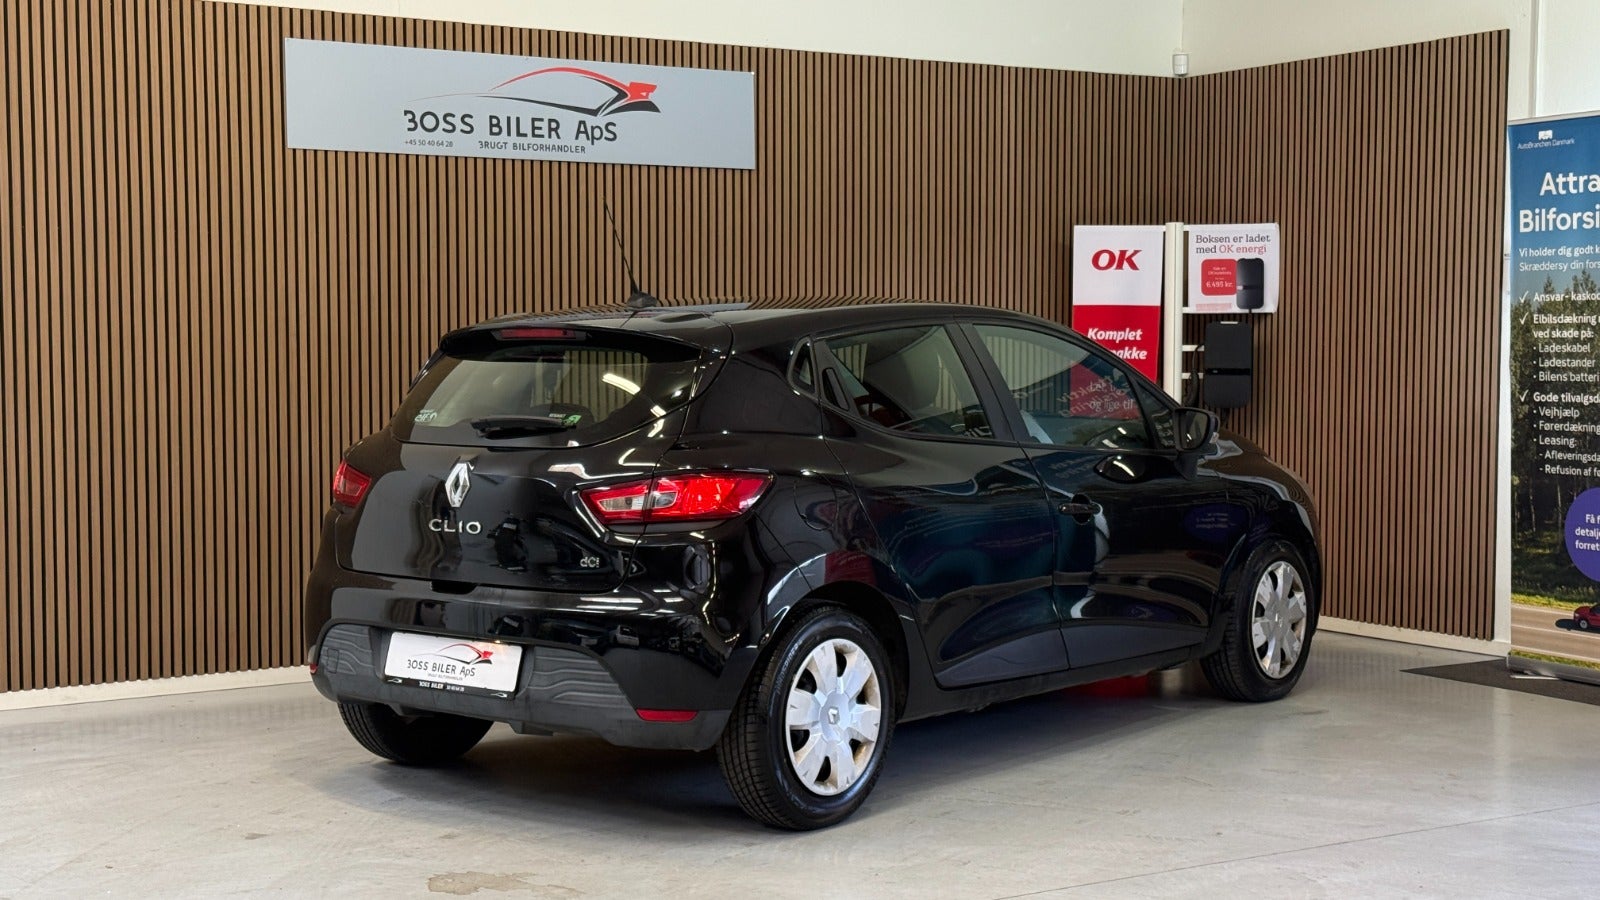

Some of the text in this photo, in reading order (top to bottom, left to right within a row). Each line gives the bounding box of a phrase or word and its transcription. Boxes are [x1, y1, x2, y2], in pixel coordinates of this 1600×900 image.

[489, 115, 561, 139] BILER
[575, 120, 618, 145] ApS
[418, 139, 426, 147] 50
[427, 139, 435, 147] 40
[512, 142, 586, 154] BILFORHANDLER
[1552, 138, 1575, 146] Danmark
[1195, 234, 1271, 243] Boksen er ladet
[1195, 244, 1267, 255] med OK energi
[1519, 248, 1528, 257] Vi
[1529, 246, 1556, 257] holder
[1557, 245, 1572, 257] dig
[1573, 245, 1594, 257] godt
[1091, 249, 1142, 270] OK
[1519, 261, 1568, 272] Skræddersy
[1570, 260, 1584, 269] din
[1533, 292, 1569, 302] Ansvar-
[1533, 312, 1597, 326] Elbilsdækning
[1088, 328, 1143, 343] Komplet
[1533, 327, 1594, 340] ved skade på:
[1538, 343, 1591, 353] Ladeskabel
[1538, 357, 1596, 367] Ladestander
[1538, 371, 1568, 382] Bilens
[1533, 392, 1559, 402] Gode
[1538, 406, 1580, 419] Vejhjælp
[1544, 464, 1582, 476] Refusion
[1583, 466, 1592, 476] af
[1585, 513, 1595, 524] Få
[428, 518, 482, 534] CLIO
[432, 662, 457, 675] BILER
[460, 667, 476, 678] ApS
